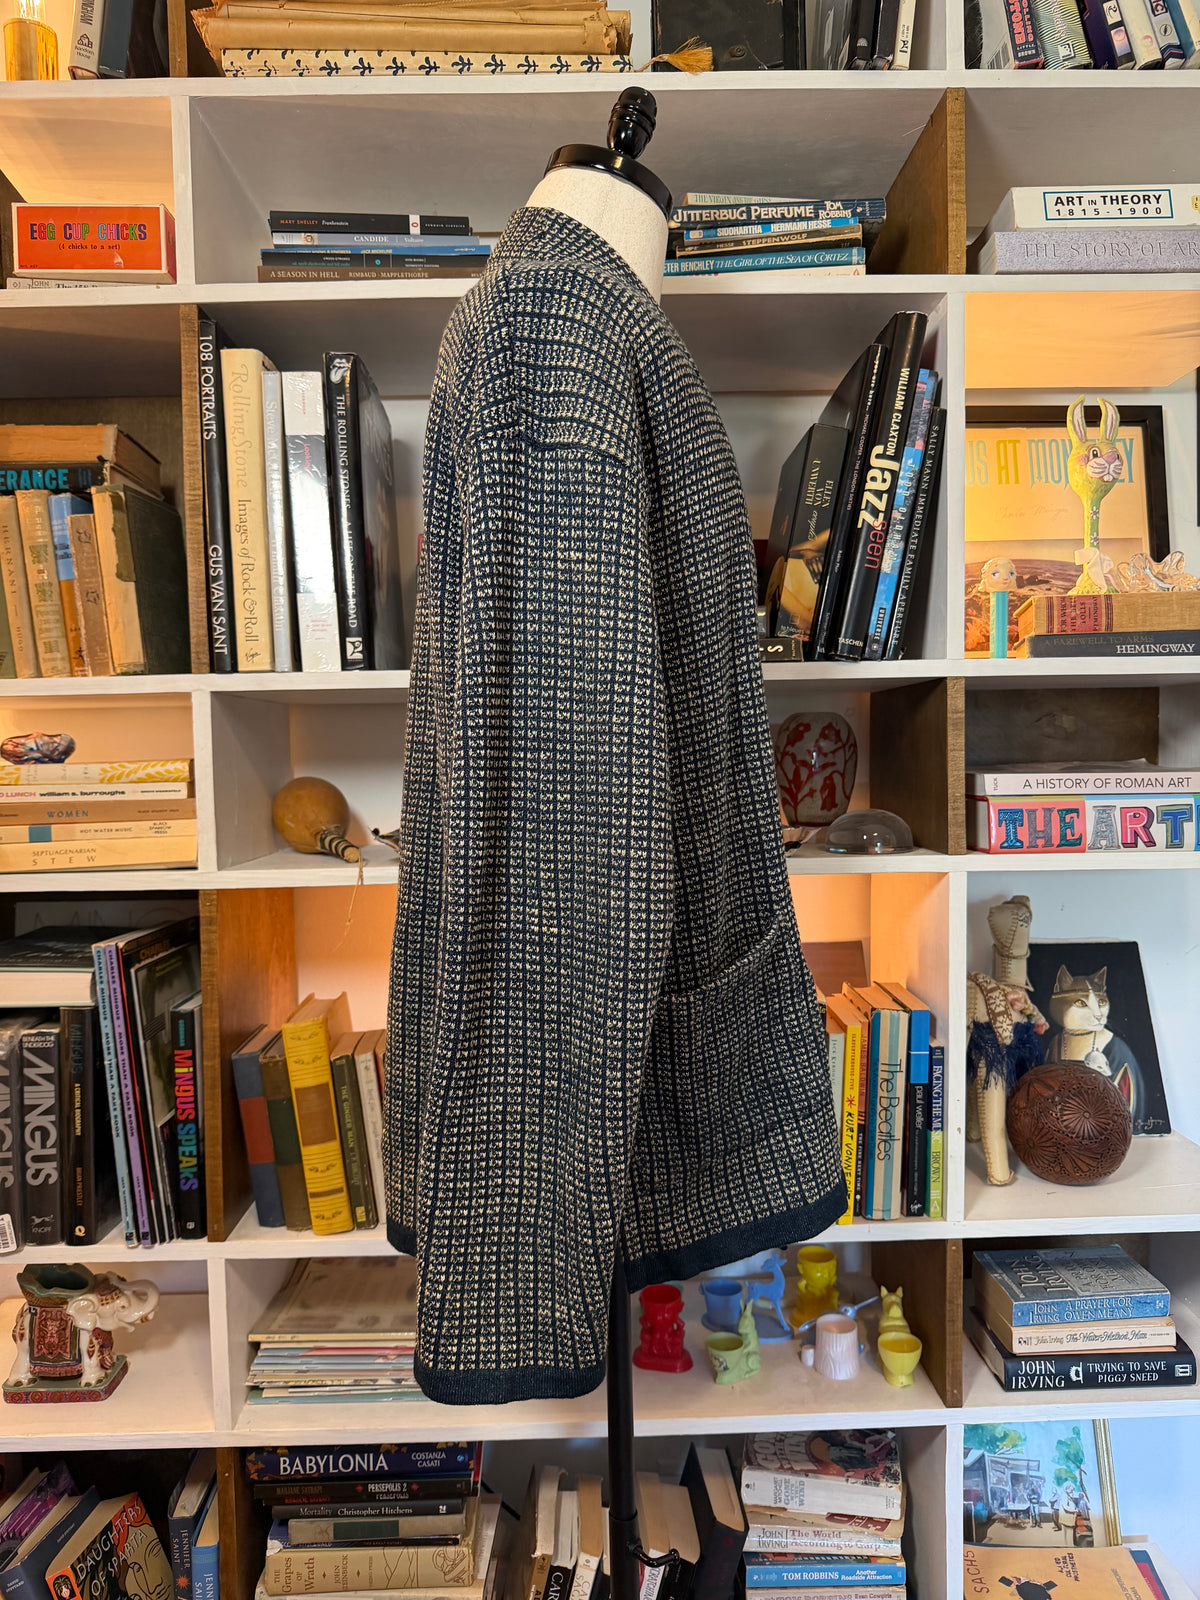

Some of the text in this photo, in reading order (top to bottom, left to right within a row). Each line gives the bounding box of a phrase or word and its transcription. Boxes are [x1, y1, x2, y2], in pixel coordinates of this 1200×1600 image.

[824, 201, 843, 211] TOM
[1054, 196, 1084, 206] ART
[1100, 194, 1162, 206] THEORY
[673, 206, 815, 224] JITTERBUG PERFUME
[818, 208, 852, 220] ROBBINS
[1056, 207, 1162, 216] 1815-1900
[30, 223, 148, 240] EGG CUP CHICKS
[716, 220, 832, 237] SIDDHARTHA HERMANN HESSE
[354, 236, 390, 244] CANDIDE
[742, 233, 808, 246] STEPPENWOLF
[1022, 242, 1167, 258] THE STORY OF
[680, 252, 849, 273] BENCHLEY THE GIRL OF THE SEA OF CORTEZ
[200, 335, 217, 441] 108 PORTRAITS
[886, 368, 910, 457] WILLIAM CLAXTON
[230, 364, 252, 488] Rolling Stone
[995, 440, 1021, 486] AT
[856, 444, 900, 529] Jazz
[335, 394, 358, 628] THE ROLLING ROAD
[235, 499, 252, 546] Images
[864, 518, 887, 570] seen
[892, 425, 940, 646] SALLY MANN IMMEDIATE FAMILY APERTURE
[241, 560, 256, 596] Rock
[209, 544, 228, 656] GUS VAN SANT
[243, 598, 258, 617] &
[244, 615, 260, 643] Roll
[838, 637, 864, 648] TASCHEN
[1053, 636, 1107, 646] FAREWELL
[1126, 635, 1155, 643] ARMS
[1116, 643, 1196, 654] HEMINGWAY
[1023, 777, 1192, 790] A HISTORY OF ROMAN ART
[80, 789, 126, 798] burroughs
[47, 810, 89, 818] WOMEN
[998, 804, 1194, 850] THE ART
[32, 848, 97, 857] SEPTUAGENARIAN
[100, 986, 108, 1022] MINGUS
[104, 1031, 114, 1054] MORE
[108, 950, 116, 985] CHARLES
[112, 986, 121, 1022] MINGUS
[117, 1031, 126, 1054] MORE
[125, 1091, 133, 1112] FAKE
[860, 1034, 868, 1060] JAMES
[859, 1062, 867, 1096] BALDWIN
[915, 1085, 924, 1105] paul
[22, 1049, 58, 1186] MINGUS
[877, 1059, 904, 1162] The Beatles
[914, 1106, 923, 1131] weller
[845, 1112, 854, 1142] KURT
[931, 1065, 943, 1184] FACING THE BROWN
[1011, 1258, 1045, 1289] JOHN
[1024, 1255, 1072, 1293] IRVING
[1034, 1303, 1058, 1314] JOHN
[1066, 1298, 1133, 1310] A PRAYER FOR
[1029, 1312, 1060, 1324] IRVING
[1064, 1307, 1133, 1321] OWEN MEANY
[1035, 1330, 1148, 1346] John Irving The Man
[1018, 1361, 1056, 1375] JOHN
[1086, 1361, 1167, 1373] TRYING TO SAVE
[1012, 1375, 1065, 1389] IRVING
[1098, 1372, 1159, 1383] PIGGY SNEED
[279, 1453, 388, 1476] BABYLONIA
[411, 1451, 446, 1461] COSTANZA
[417, 1460, 440, 1468] CASATI
[367, 1482, 408, 1493] PERSEPOLIS 2
[300, 1506, 413, 1517] Mortality Christopher Hitchens
[76, 1500, 146, 1580] DAUGHTERS
[758, 1535, 787, 1549] IRVING
[761, 1528, 784, 1539] JOHN
[790, 1530, 842, 1539] The World
[108, 1529, 148, 1577] SPARTA
[172, 1538, 180, 1564] SAINT
[179, 1529, 191, 1569] JENNIFER
[854, 1540, 882, 1552] Garp
[282, 1557, 292, 1593] Grapes
[304, 1557, 315, 1592] Wrath
[782, 1571, 839, 1581] TOM ROBBINS
[90, 1571, 108, 1598] OF
